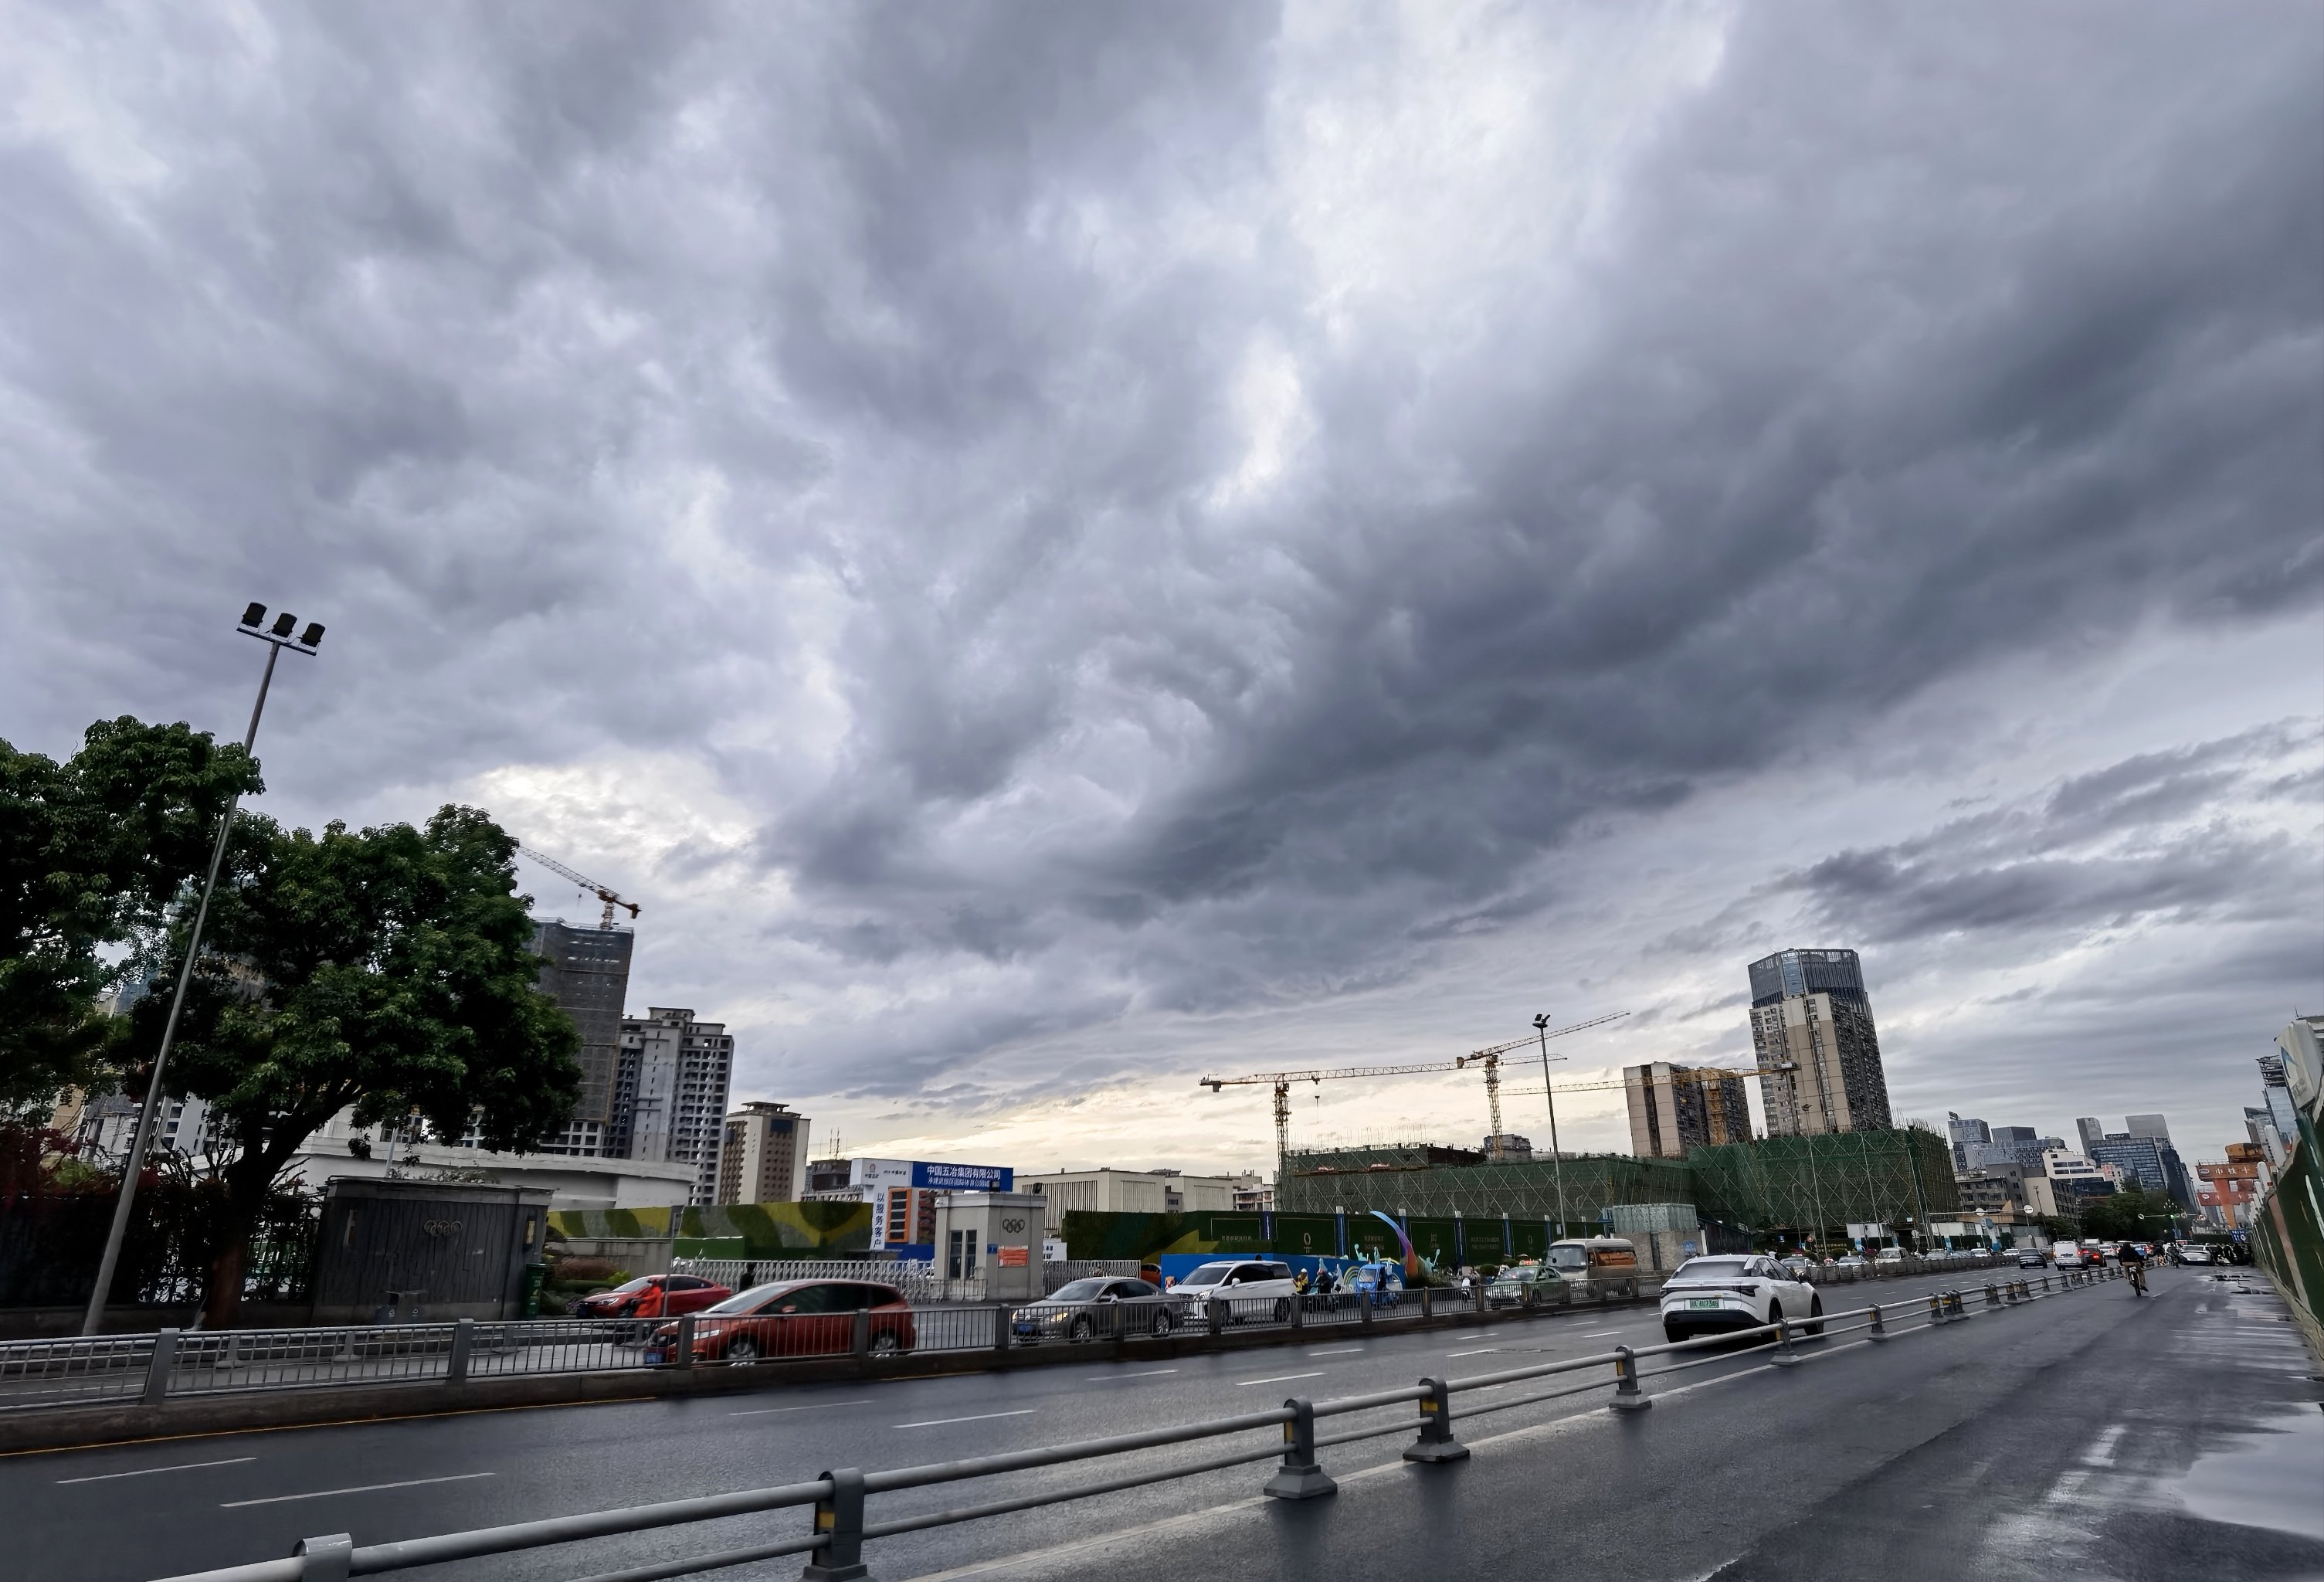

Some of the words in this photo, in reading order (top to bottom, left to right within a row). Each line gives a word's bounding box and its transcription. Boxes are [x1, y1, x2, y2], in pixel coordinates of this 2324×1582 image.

[927, 1165, 1000, 1180] 中国五冶集团有限公司
[874, 1192, 884, 1249] 以服务客户
